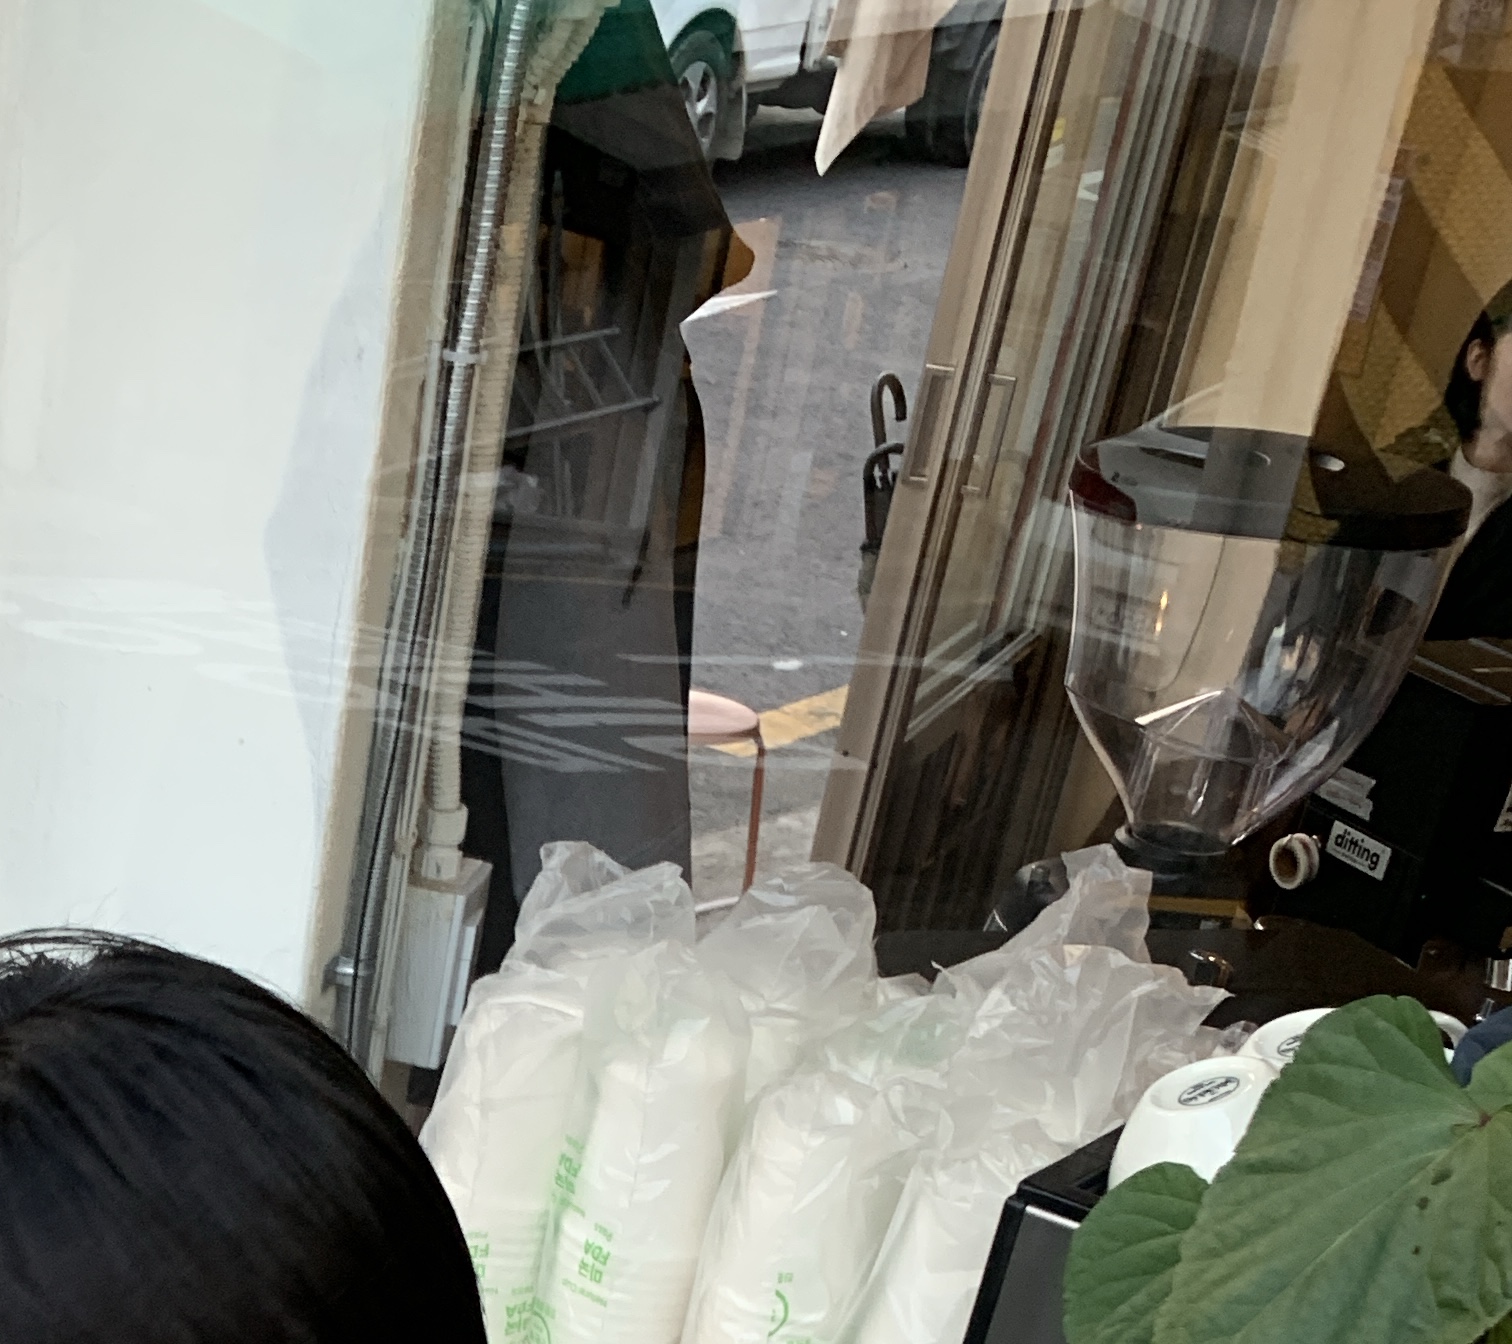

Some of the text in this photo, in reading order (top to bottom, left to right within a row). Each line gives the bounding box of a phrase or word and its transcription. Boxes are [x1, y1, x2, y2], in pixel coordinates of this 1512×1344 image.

[1335, 829, 1380, 870] ditting
[585, 1238, 611, 1266] FDA
[578, 1257, 603, 1284] 미국
